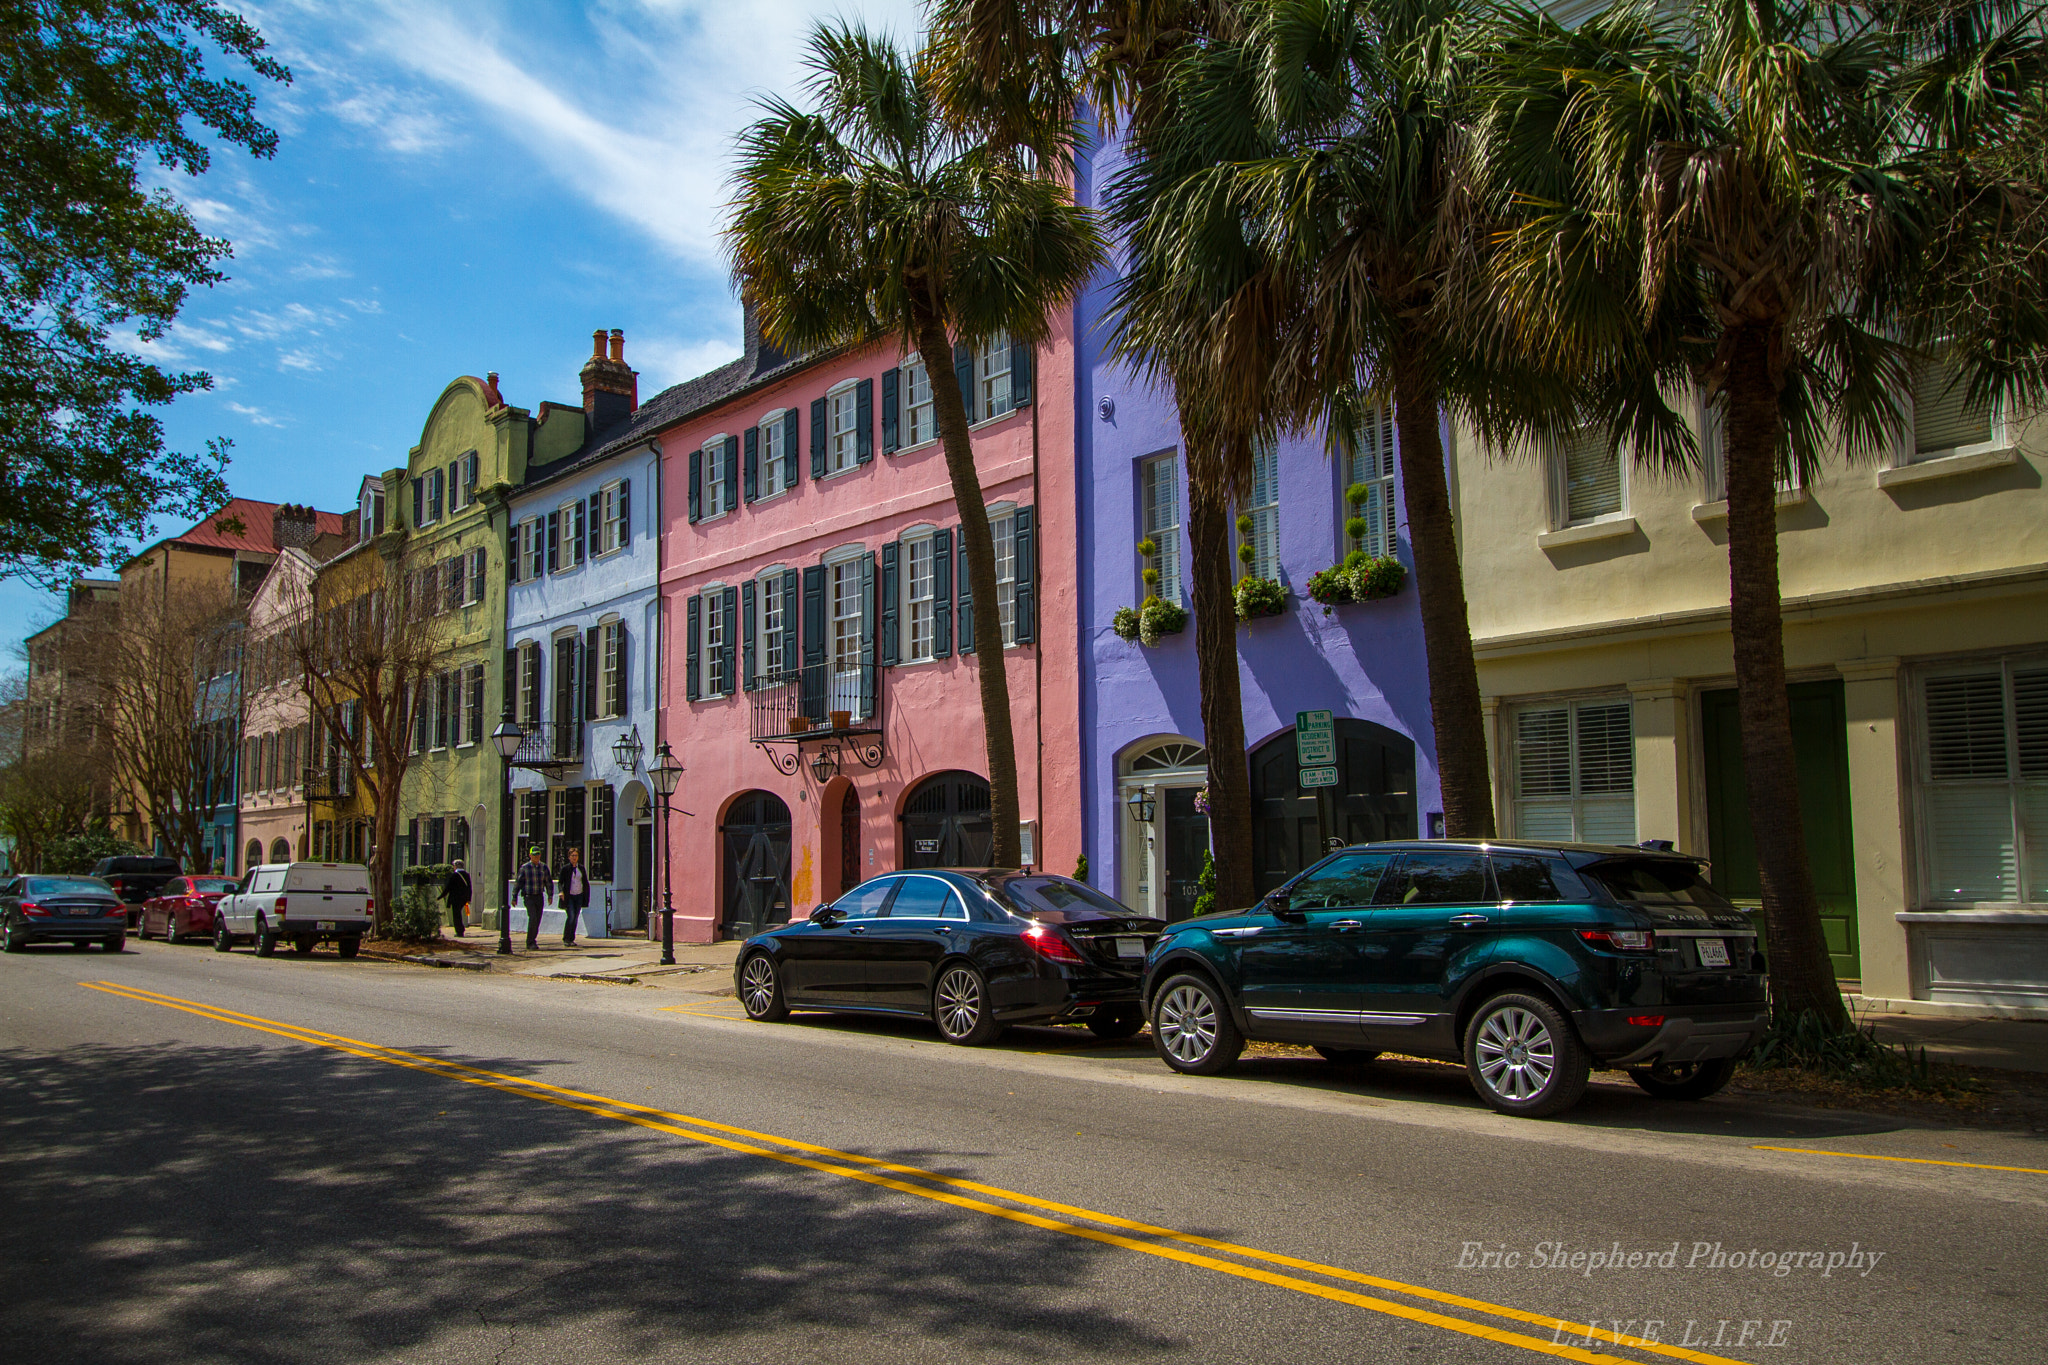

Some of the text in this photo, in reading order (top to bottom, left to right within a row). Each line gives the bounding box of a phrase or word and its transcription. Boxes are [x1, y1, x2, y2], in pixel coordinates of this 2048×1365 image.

[1300, 715, 1304, 729] 1
[1308, 721, 1331, 729] PARKING
[1301, 732, 1330, 740] RESIDENTIAL
[1302, 746, 1324, 754] DISTRICT
[1182, 885, 1198, 896] 103
